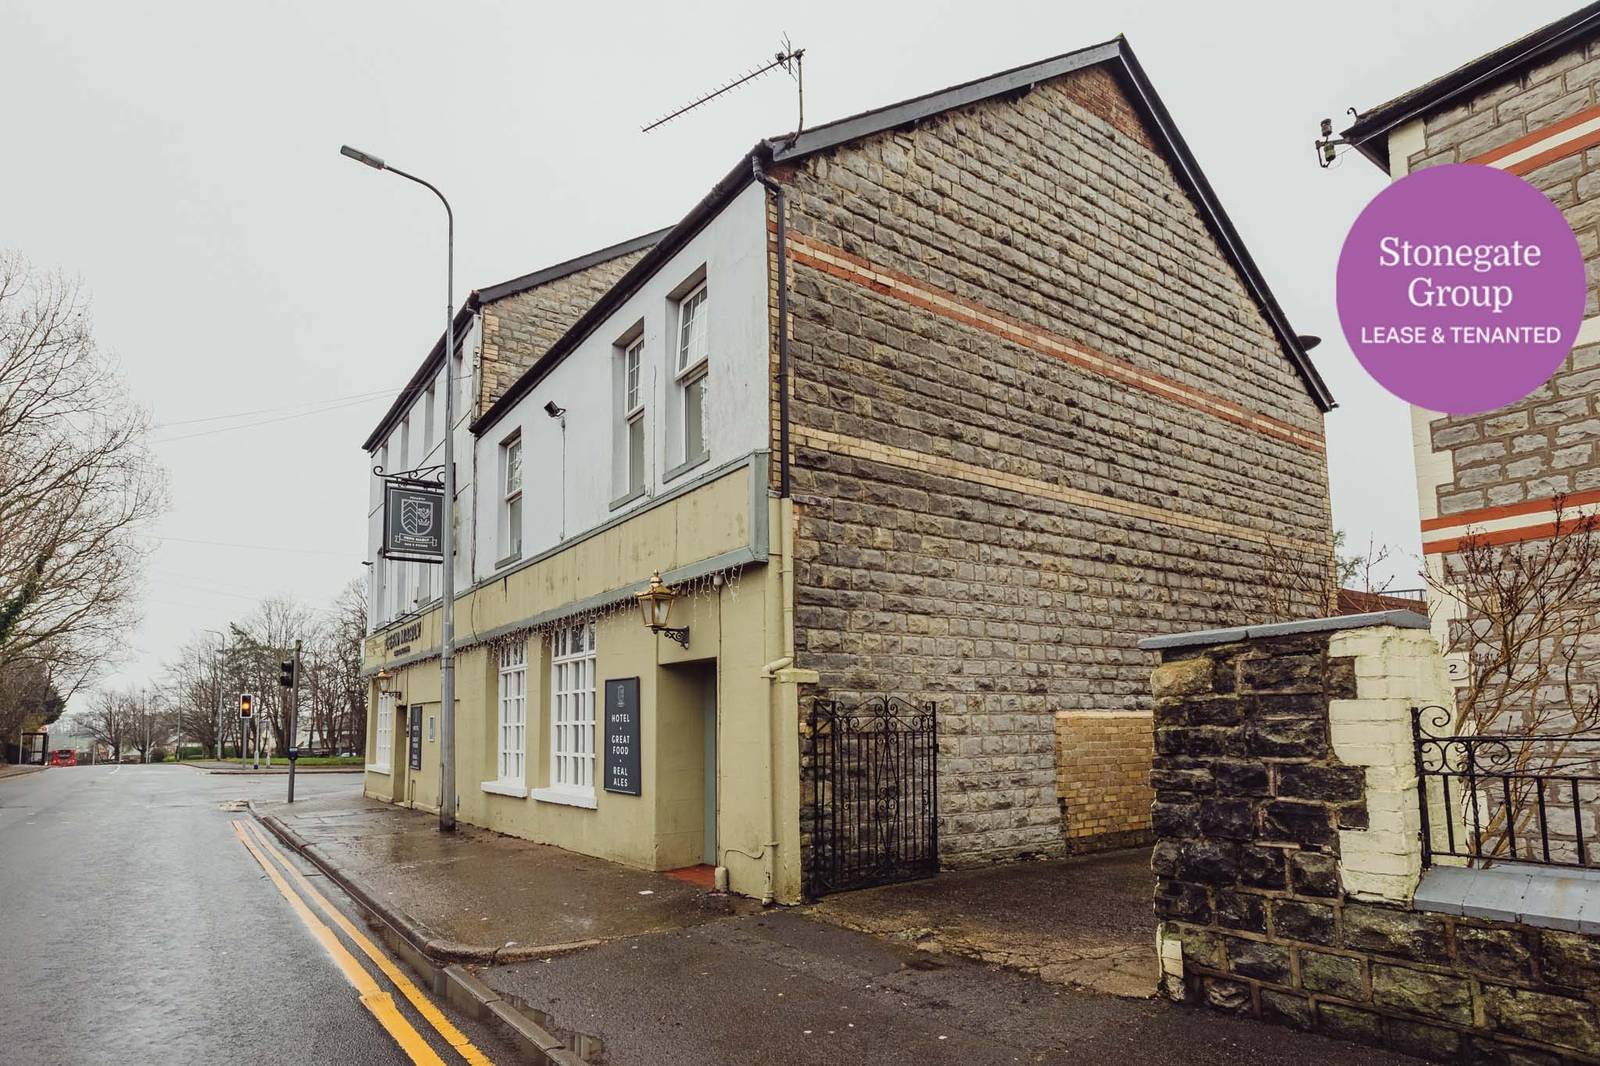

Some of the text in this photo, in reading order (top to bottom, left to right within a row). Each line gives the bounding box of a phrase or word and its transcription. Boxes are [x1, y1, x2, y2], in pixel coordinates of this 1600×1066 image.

[611, 714, 630, 722] HOTEL
[611, 735, 630, 744] GREAT
[613, 746, 629, 755] FOOD
[613, 766, 628, 776] REAL
[613, 778, 628, 787] ALES
